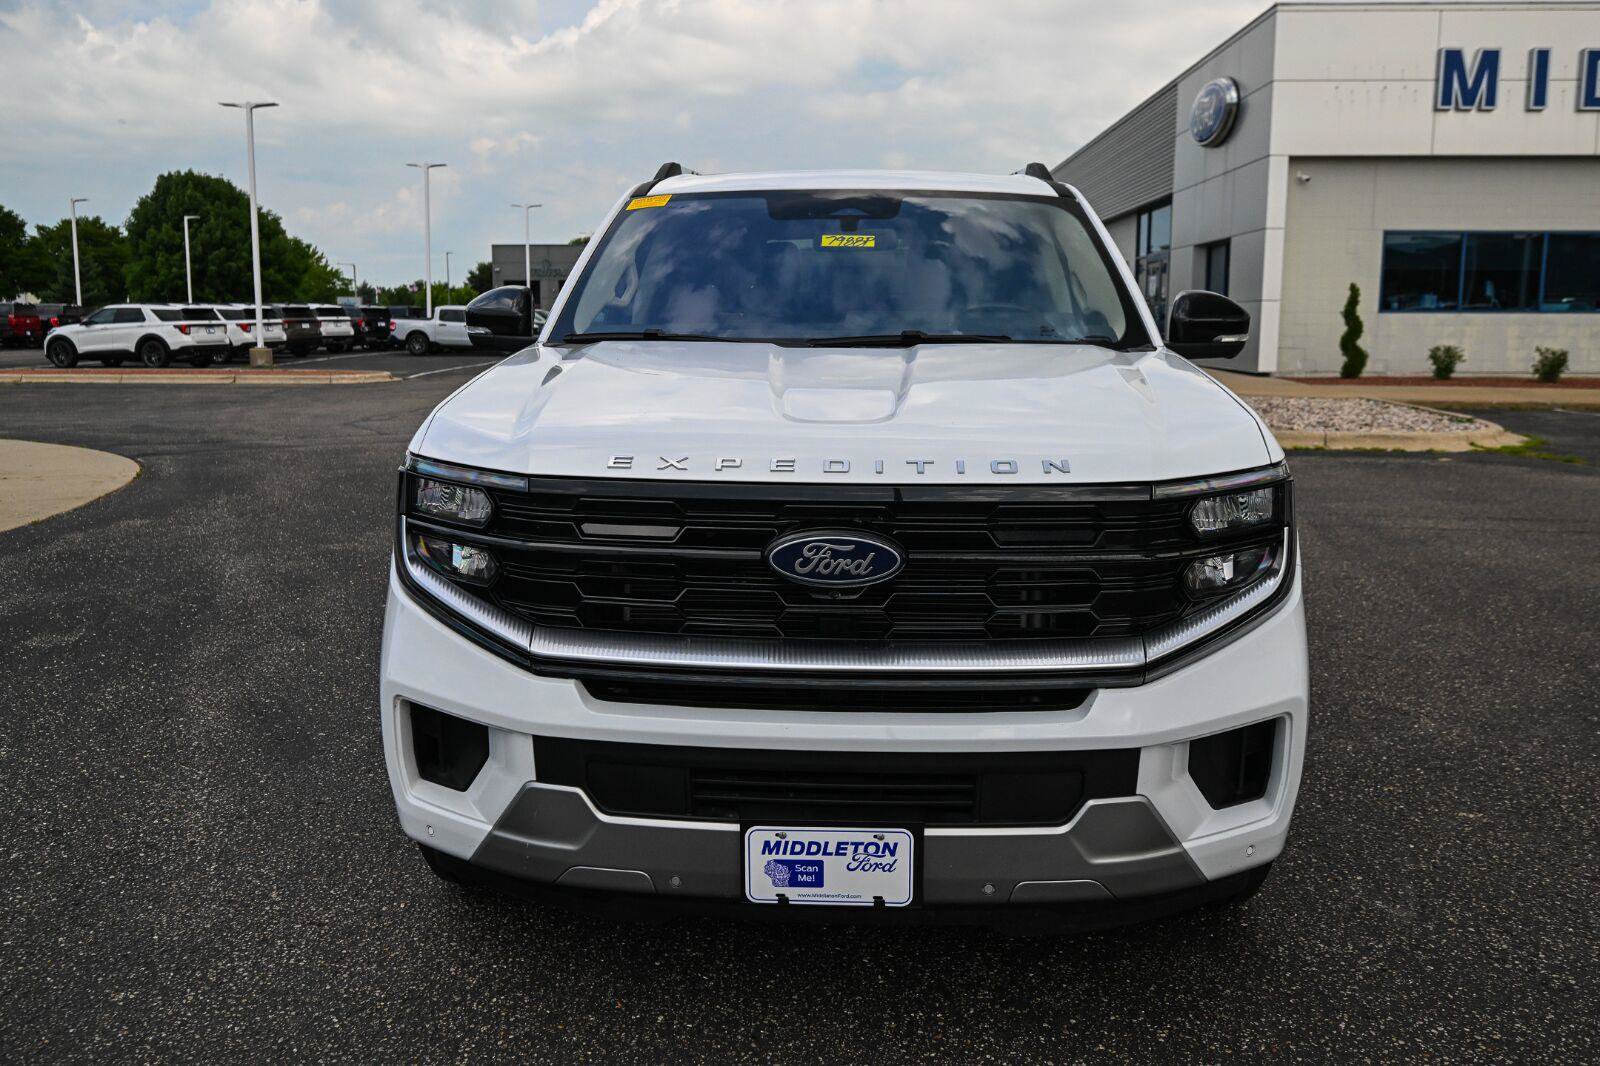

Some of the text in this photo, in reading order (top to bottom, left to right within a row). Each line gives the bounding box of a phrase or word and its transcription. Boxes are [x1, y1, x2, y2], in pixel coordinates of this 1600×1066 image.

[606, 455, 1071, 475] EXPEDITION
[794, 543, 876, 575] Ford
[761, 840, 899, 858] MIDDLETON
[795, 864, 819, 872] Scan
[846, 853, 898, 873] Ford
[797, 874, 816, 882] Me!
